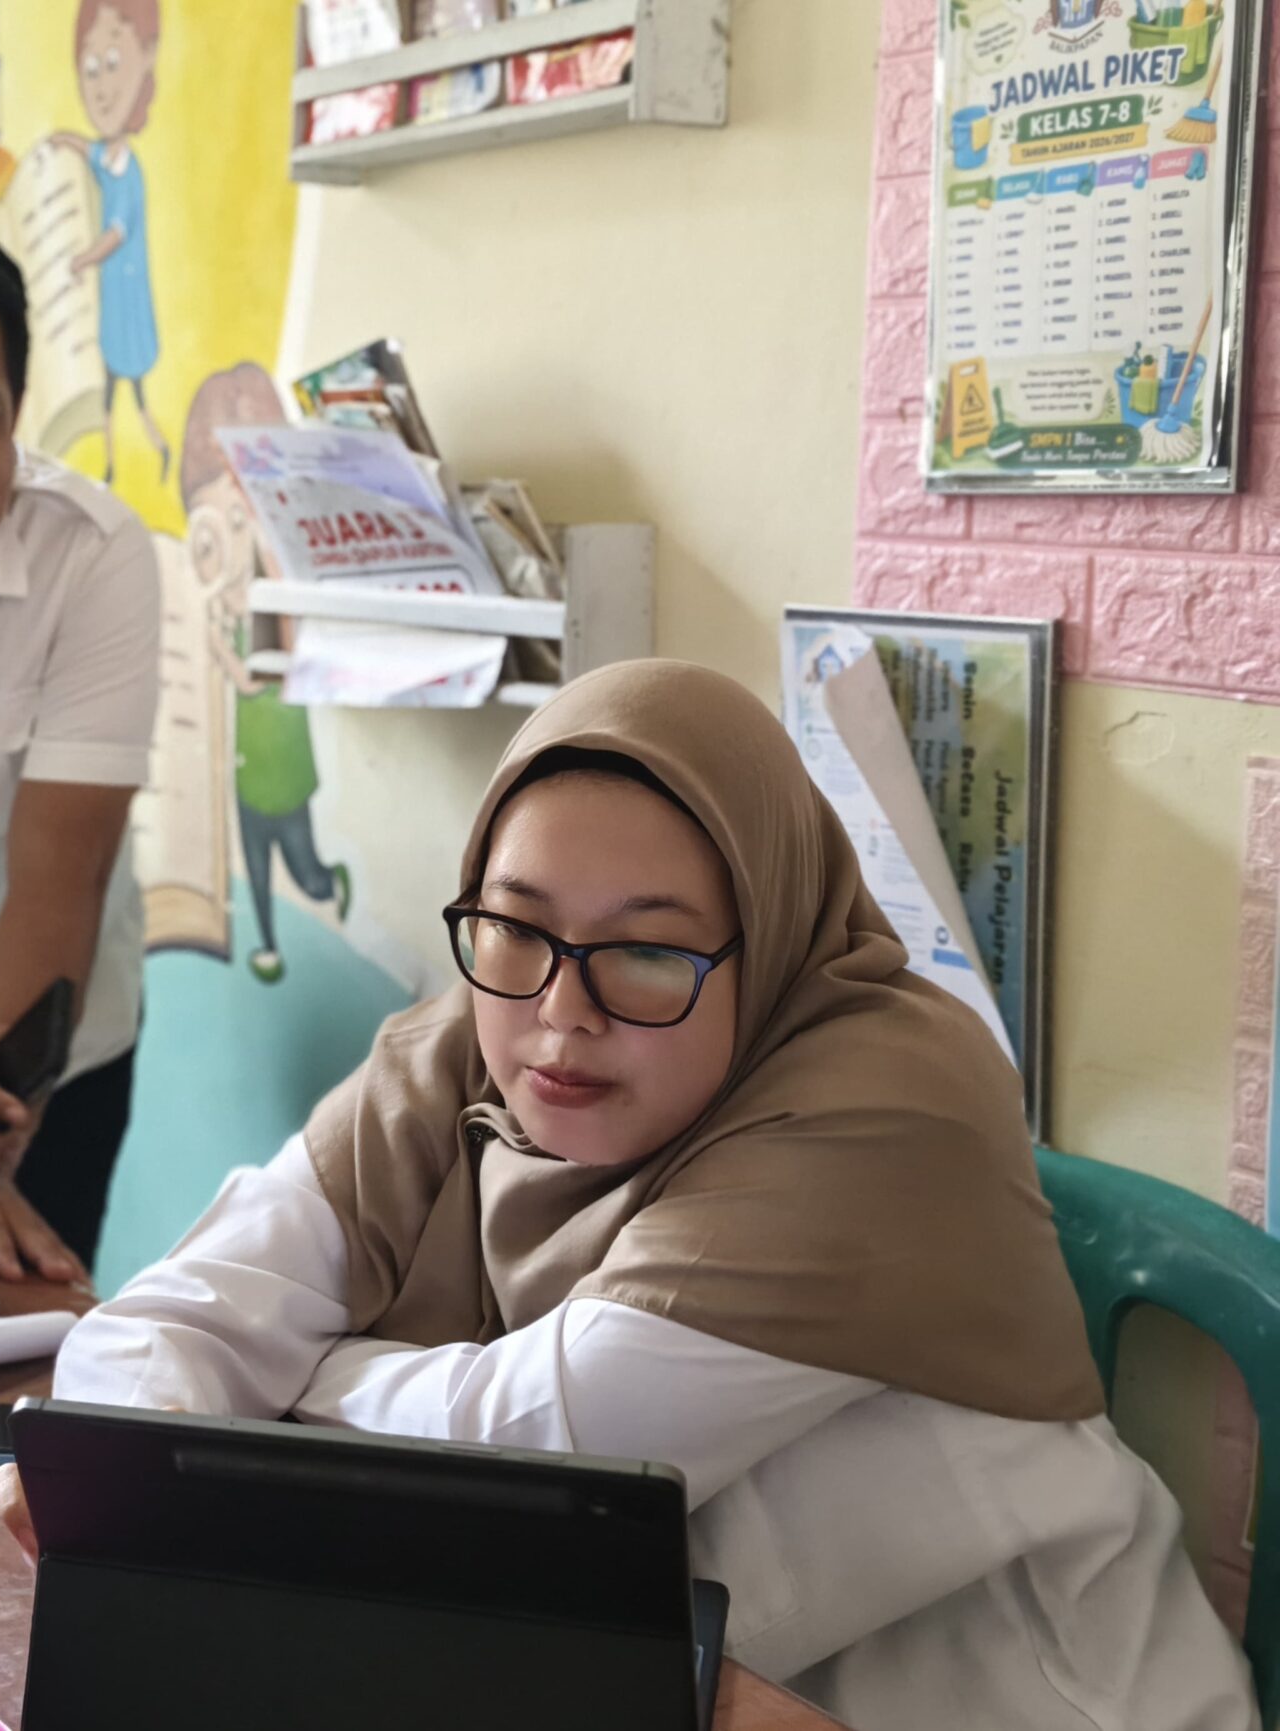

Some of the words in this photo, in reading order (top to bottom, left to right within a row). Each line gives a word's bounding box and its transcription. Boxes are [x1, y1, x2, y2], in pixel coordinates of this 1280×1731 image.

[989, 59, 1095, 113] JADWAL
[1104, 47, 1185, 87] PIKET
[1030, 107, 1093, 137] KELAS
[1099, 101, 1131, 125] 7-8
[1051, 140, 1087, 154] AJARAN
[297, 510, 404, 548] JUARA
[962, 661, 978, 720] Senin
[994, 769, 1013, 856] Jadwal
[987, 865, 1013, 985] Pelajaran
